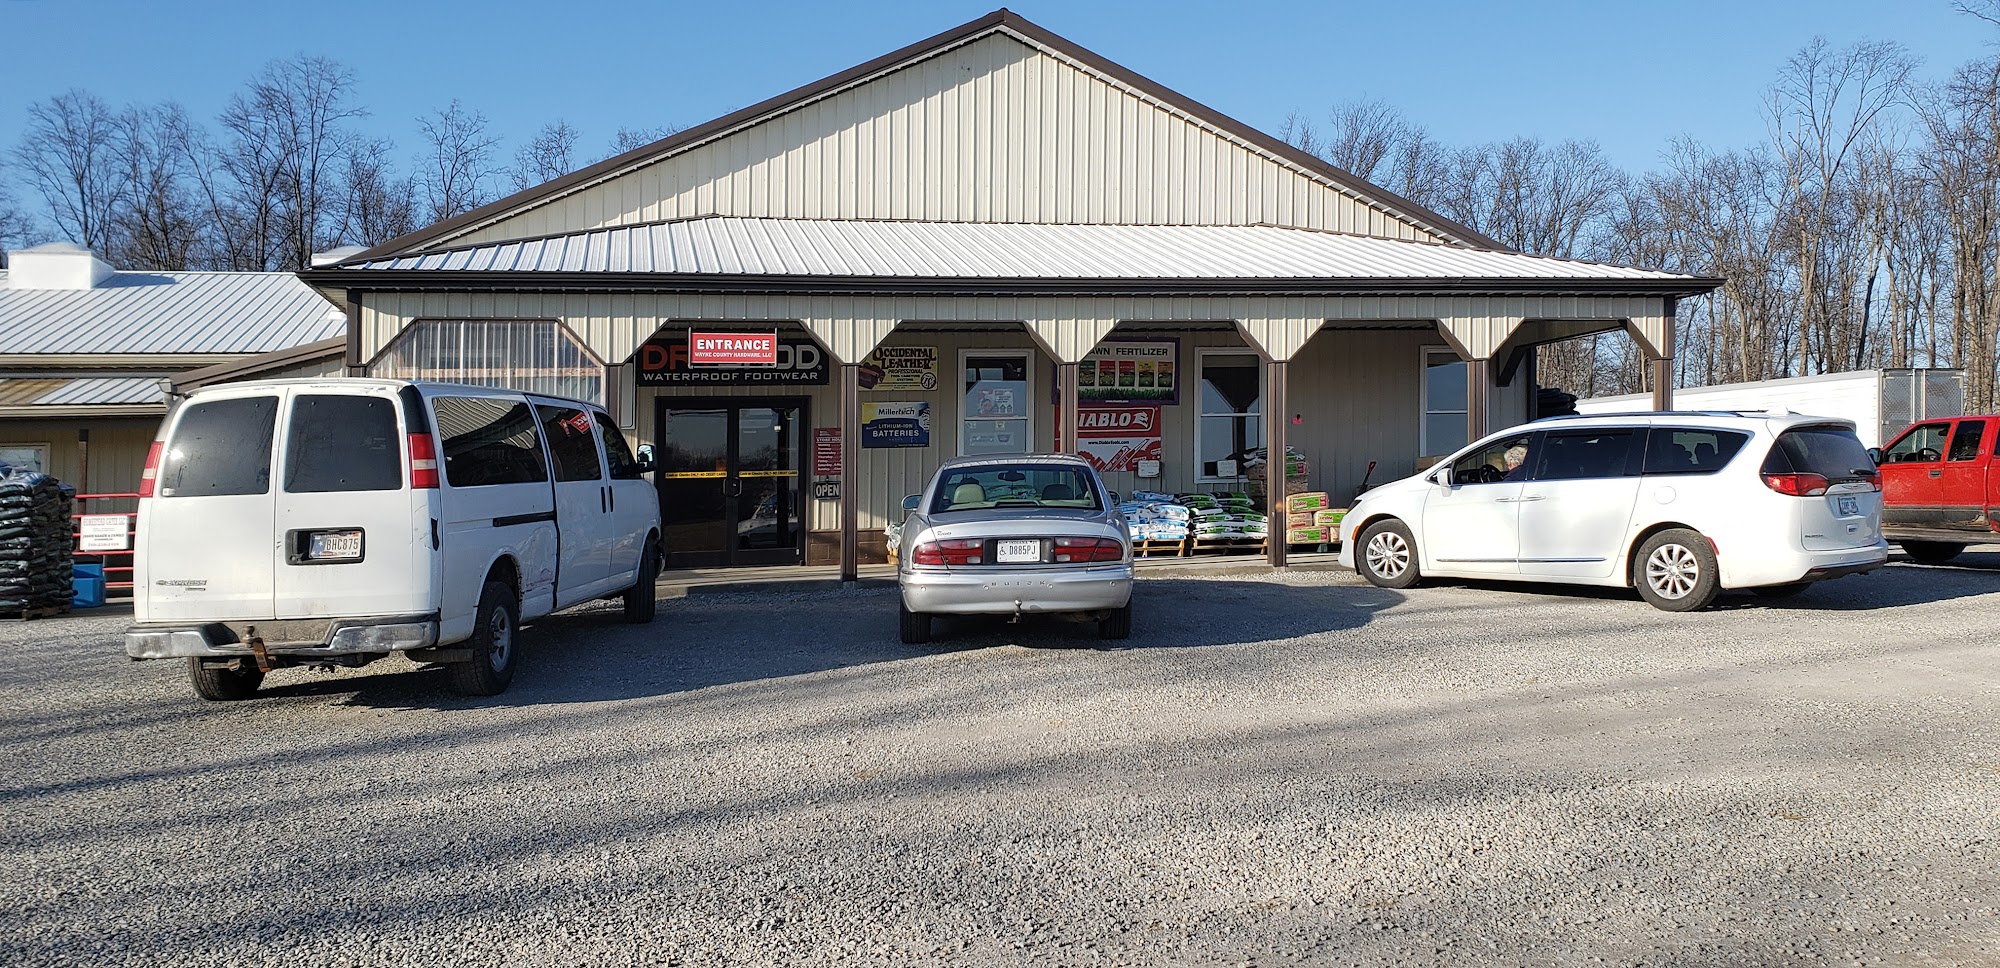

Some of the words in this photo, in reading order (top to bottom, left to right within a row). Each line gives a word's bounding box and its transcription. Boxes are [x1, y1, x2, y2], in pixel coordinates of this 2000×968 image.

[697, 339, 770, 350] ENTRANCE
[872, 347, 937, 361] OCCIDENTAL
[1116, 348, 1168, 356] FERTILIZER
[881, 358, 932, 369] LEATHER
[643, 373, 740, 381] WATERPROOF
[744, 372, 818, 380] FOOTWEAR
[1078, 412, 1131, 427] IABLO
[873, 430, 920, 438] BATTERIES
[815, 484, 839, 497] OPEN
[326, 538, 359, 550] BHC875
